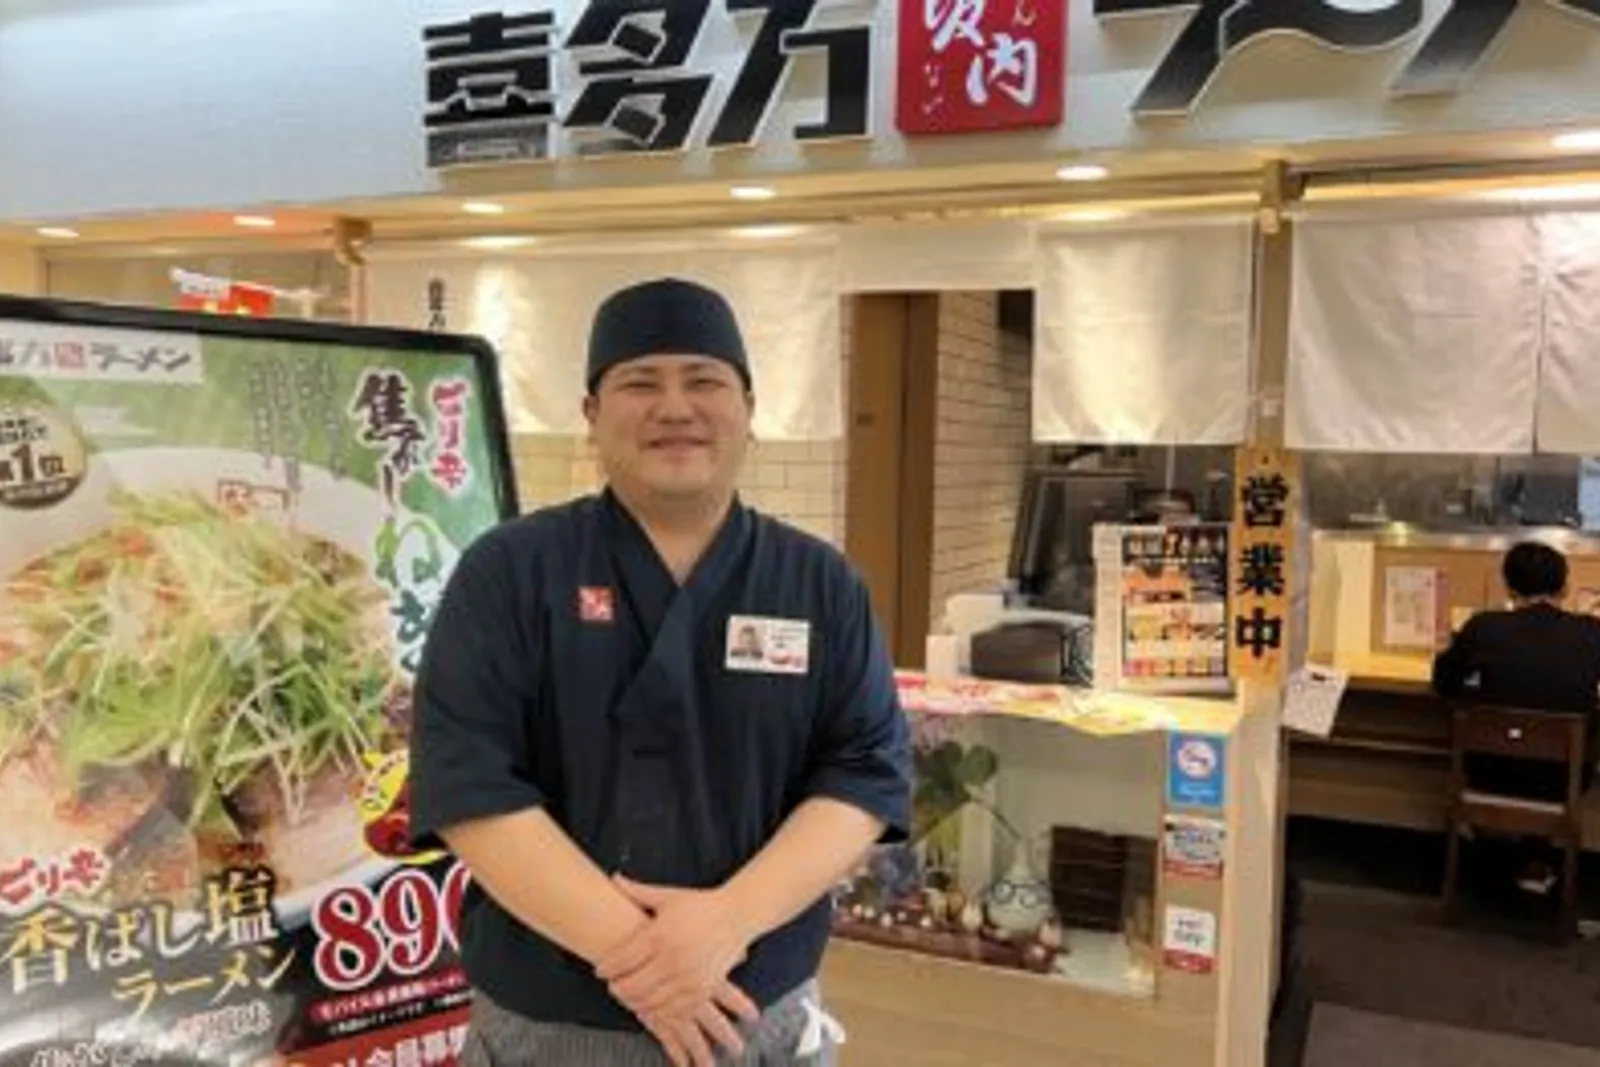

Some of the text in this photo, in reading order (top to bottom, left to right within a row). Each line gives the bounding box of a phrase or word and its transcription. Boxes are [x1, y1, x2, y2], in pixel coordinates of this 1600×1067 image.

[423, 0, 872, 169] 喜多方
[90, 340, 192, 374] ラーメン
[1237, 472, 1287, 660] 営業中
[0, 868, 279, 994] 香ばし塩
[111, 949, 295, 1022] ラーメン
